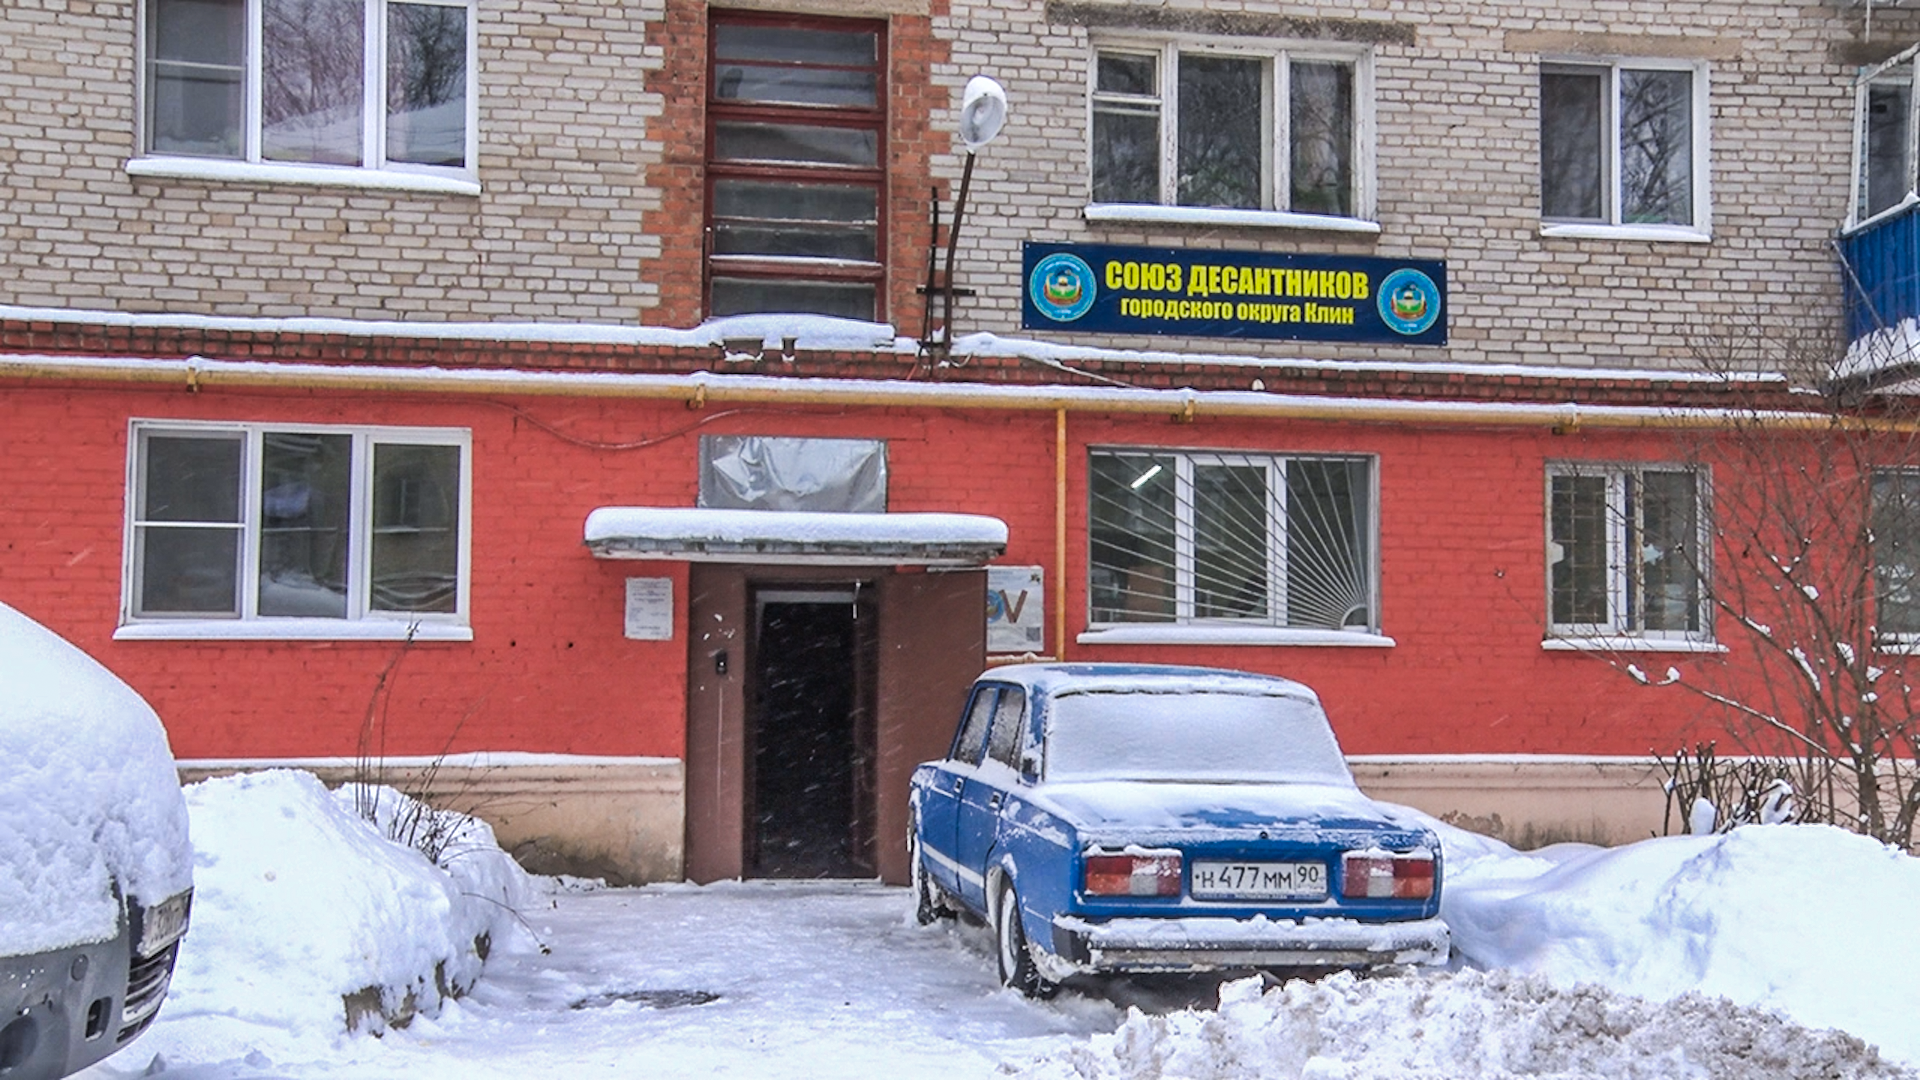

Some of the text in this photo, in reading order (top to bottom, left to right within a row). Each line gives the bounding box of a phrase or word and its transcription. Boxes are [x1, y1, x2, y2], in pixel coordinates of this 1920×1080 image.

[1105, 261, 1369, 300] СОЮЗ ДЕСАНТНИКОВ
[1121, 298, 1354, 324] городского округа Клин
